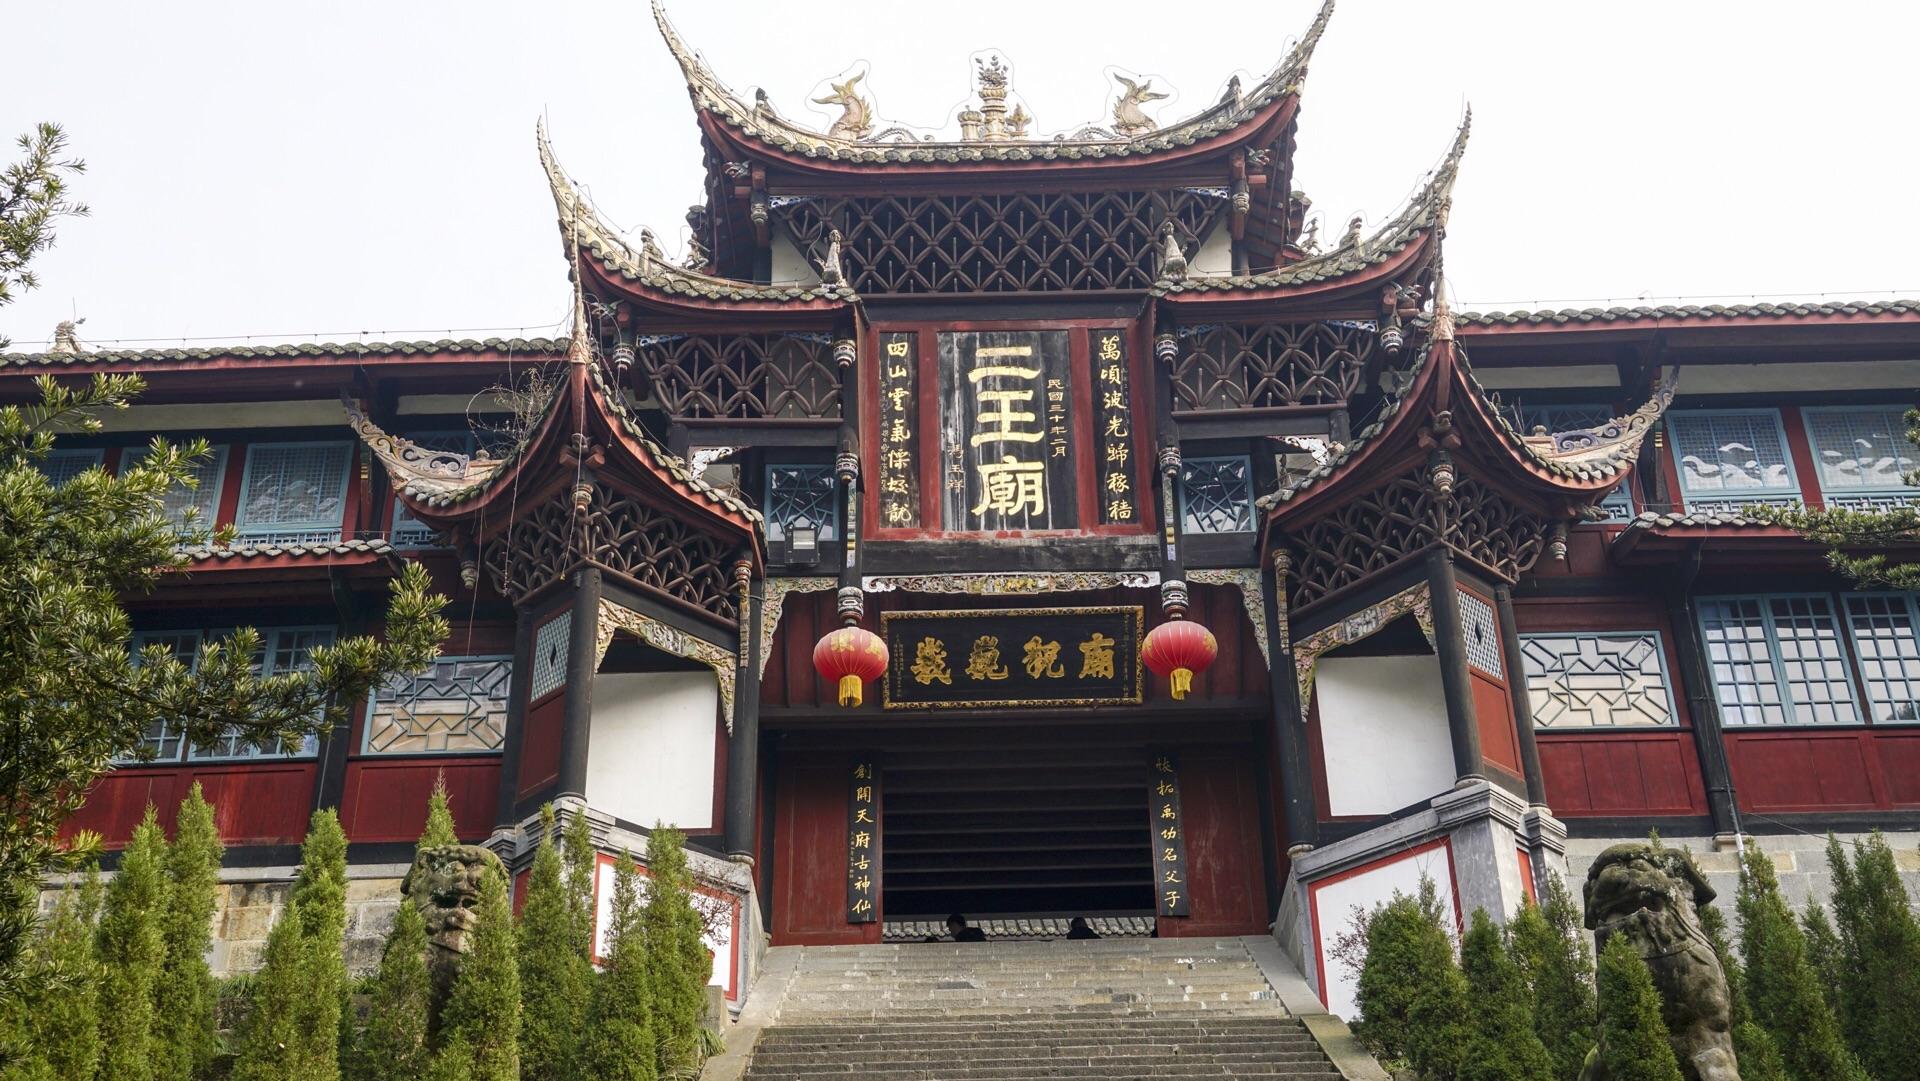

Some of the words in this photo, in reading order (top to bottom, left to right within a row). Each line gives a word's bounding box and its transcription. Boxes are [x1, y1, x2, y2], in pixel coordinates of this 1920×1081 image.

[968, 345, 1045, 517] 二王廟
[1047, 379, 1067, 457] 民國三十年二月
